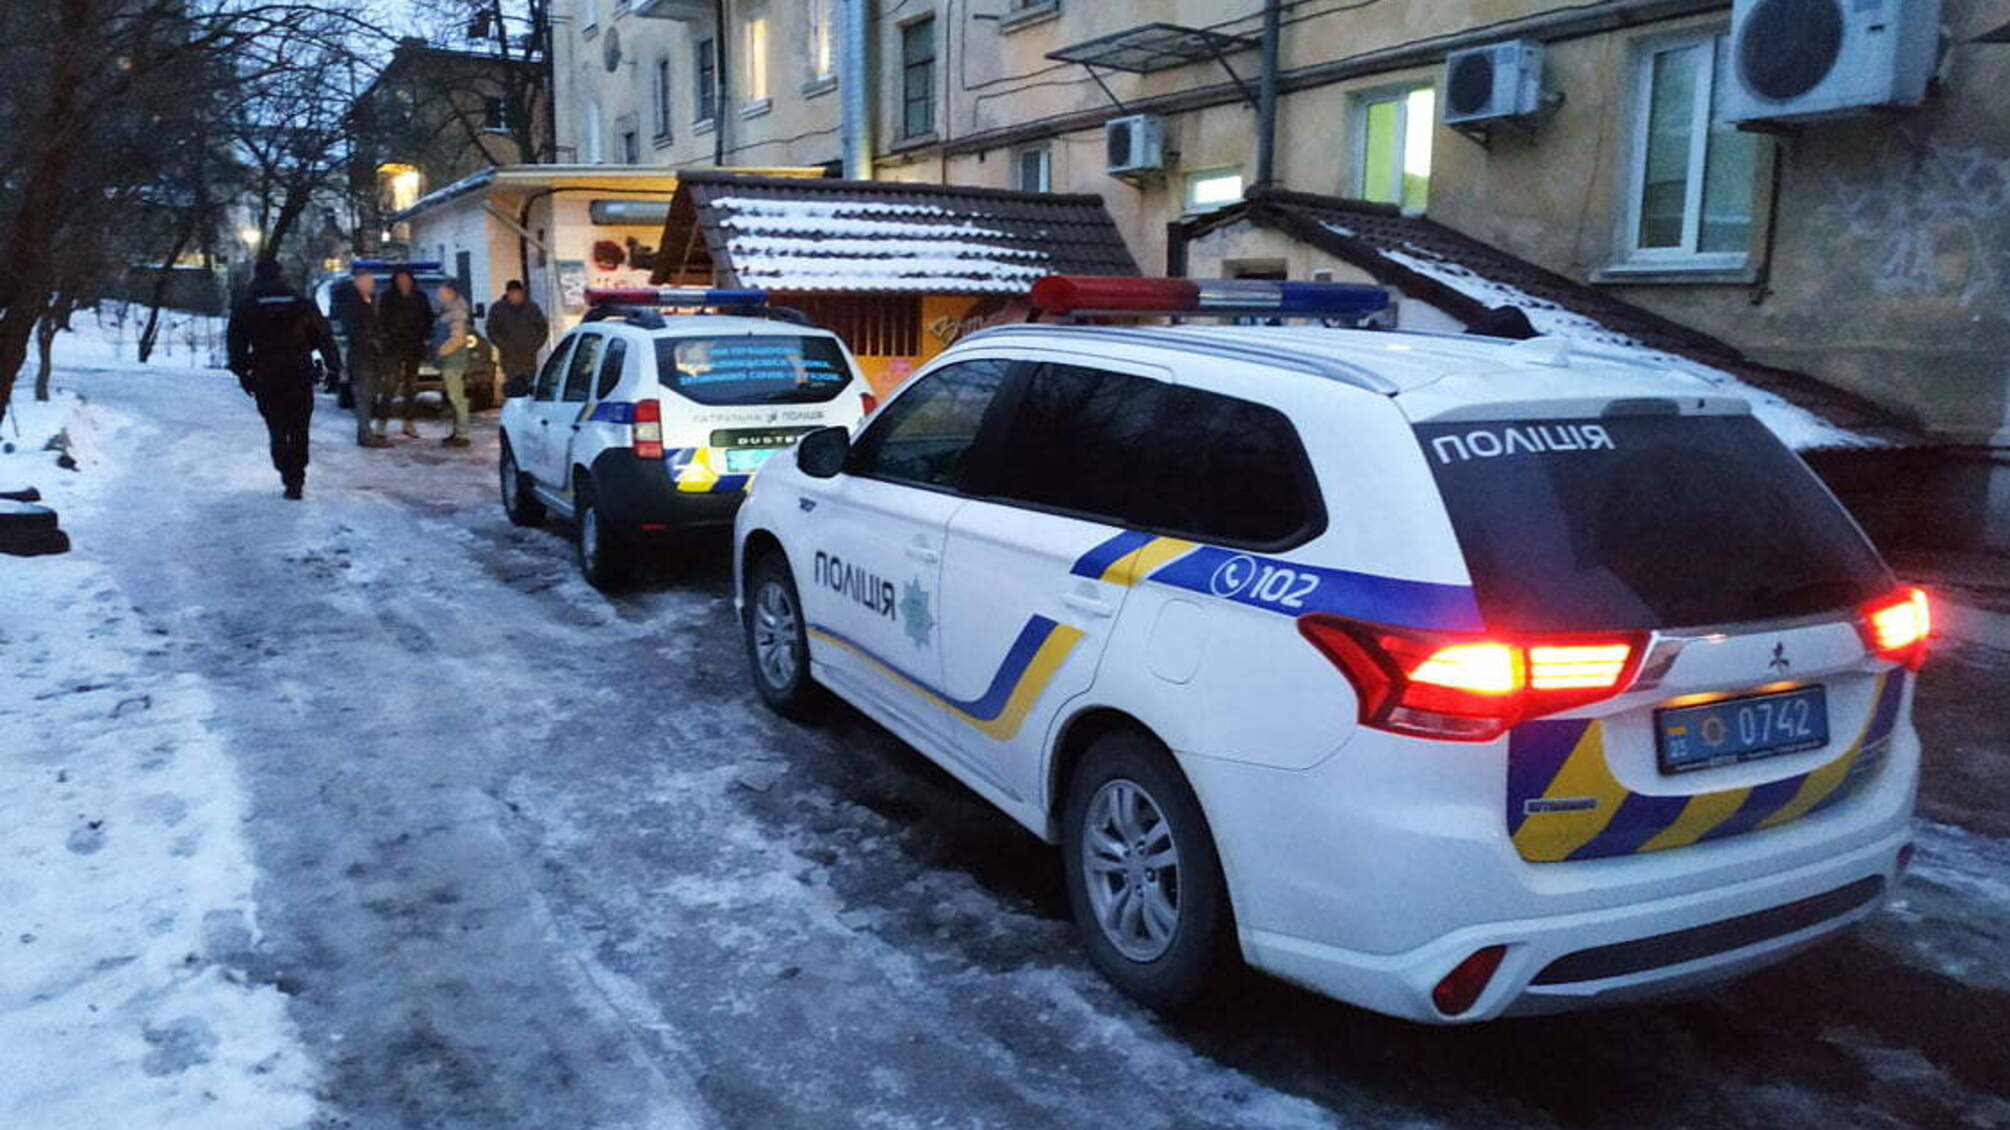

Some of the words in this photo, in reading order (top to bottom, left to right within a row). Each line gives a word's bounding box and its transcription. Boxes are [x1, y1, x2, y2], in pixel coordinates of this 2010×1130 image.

[1433, 425, 1615, 463] ПОЛІЦІЯ
[814, 550, 896, 621] ПОЛІЦІЯ
[1249, 564, 1320, 607] 102
[1738, 698, 1812, 746] 0742
